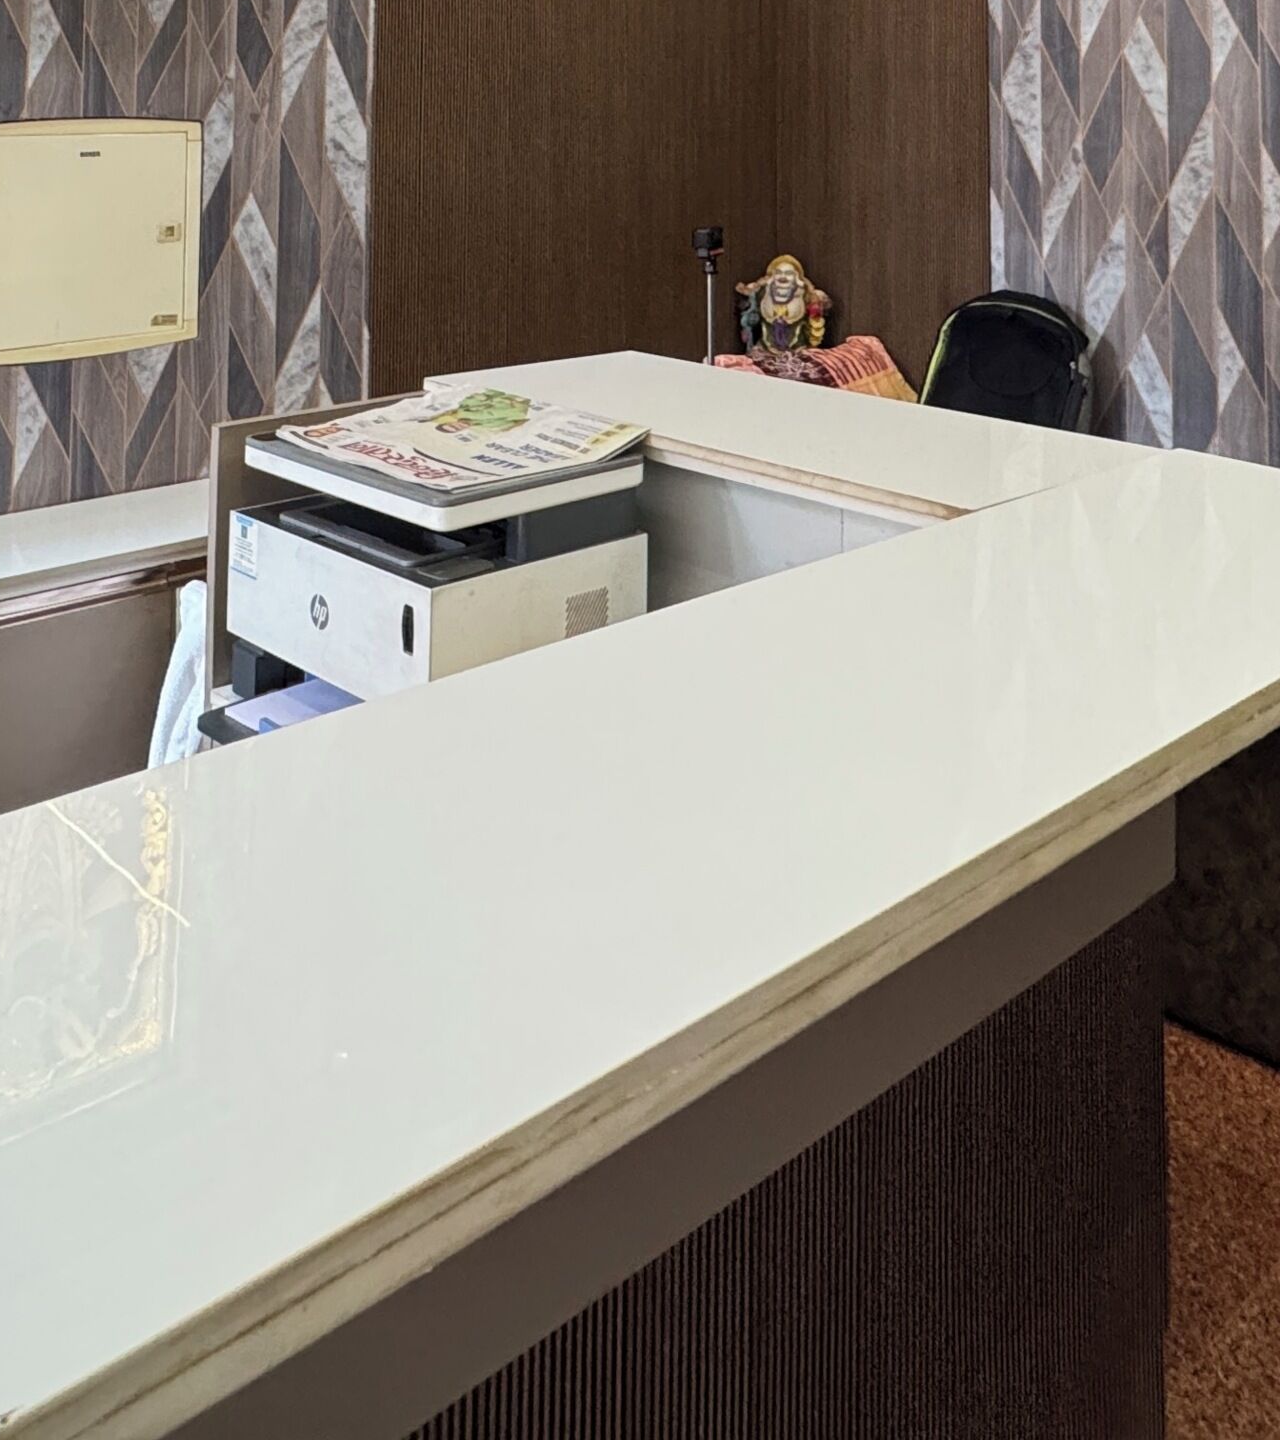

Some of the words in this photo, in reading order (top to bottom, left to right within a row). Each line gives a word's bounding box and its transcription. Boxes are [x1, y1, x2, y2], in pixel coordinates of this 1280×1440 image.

[486, 442, 529, 459] CLEAR
[472, 454, 527, 470] ALLEN
[312, 592, 328, 630] hp
